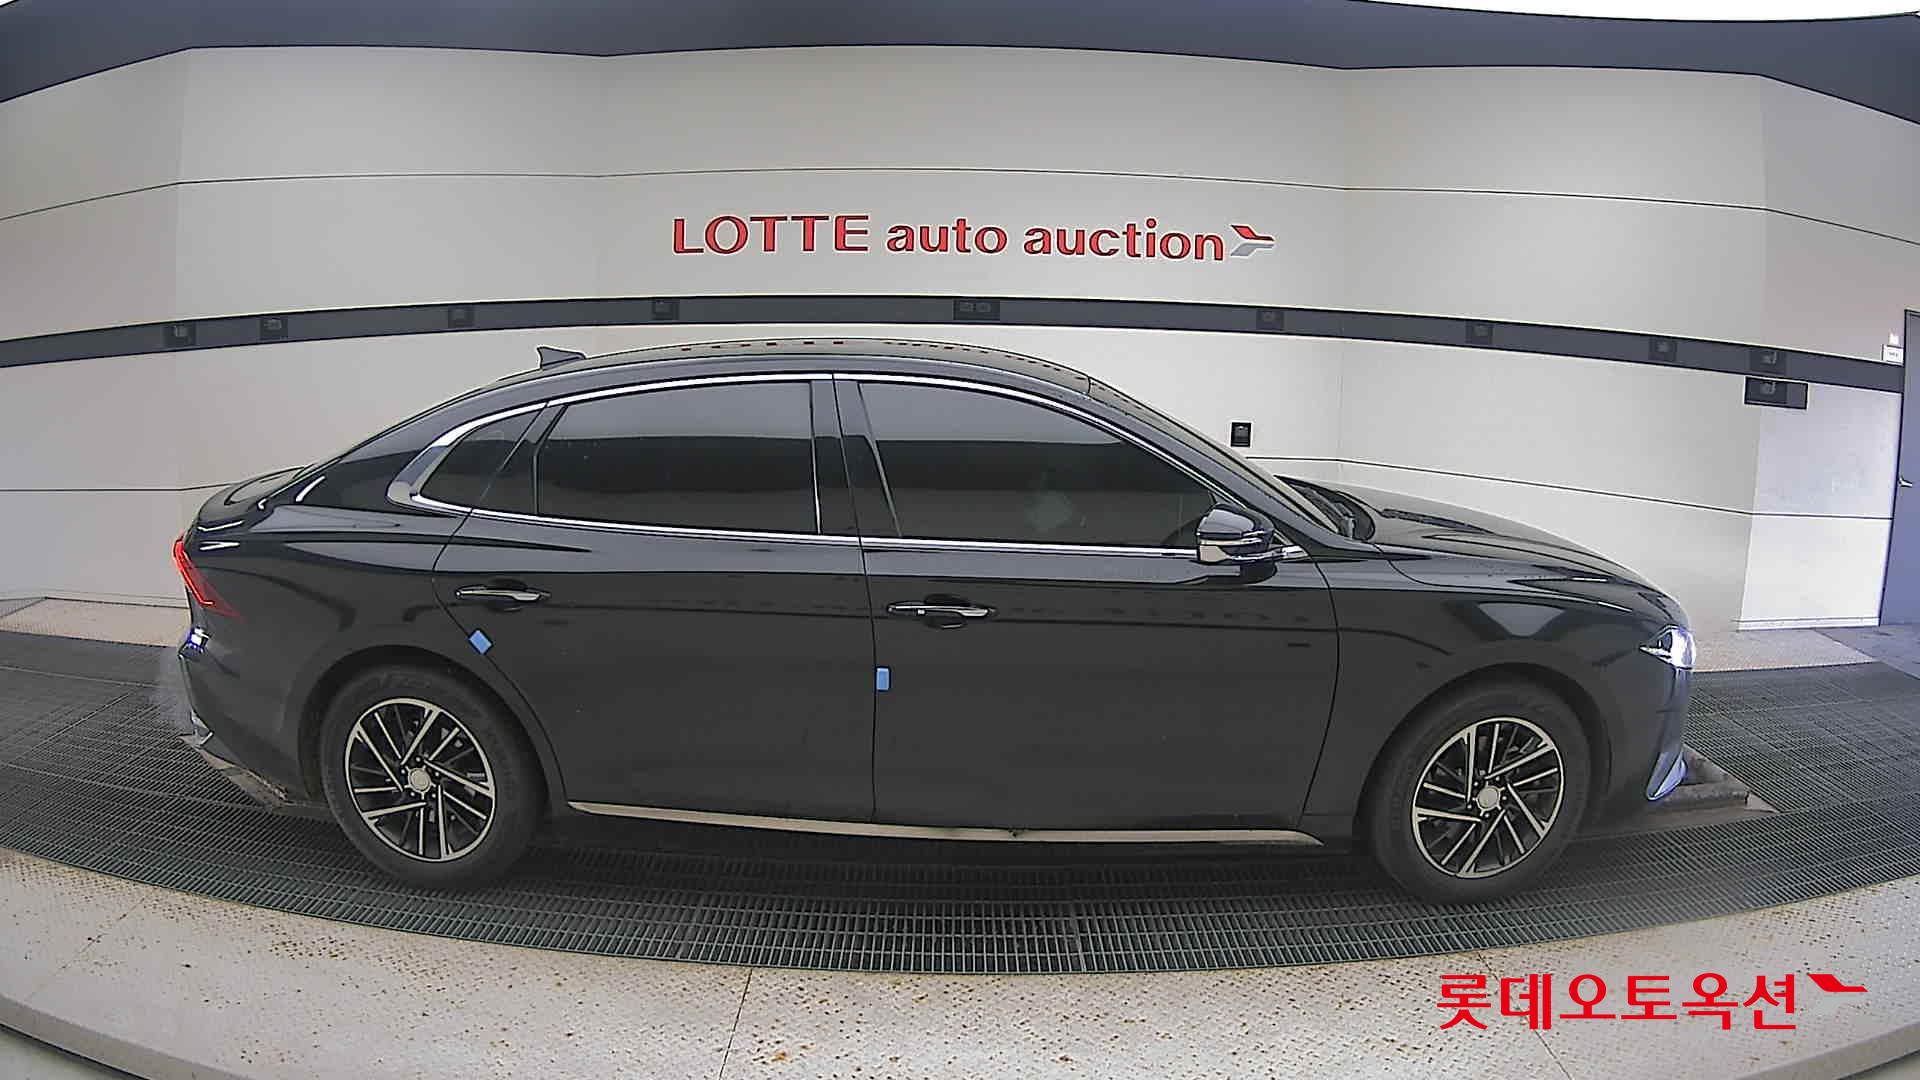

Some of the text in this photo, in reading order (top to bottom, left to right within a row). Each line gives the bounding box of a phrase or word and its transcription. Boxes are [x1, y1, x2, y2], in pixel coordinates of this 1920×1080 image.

[673, 215, 1225, 261] LOTTE auto auction
